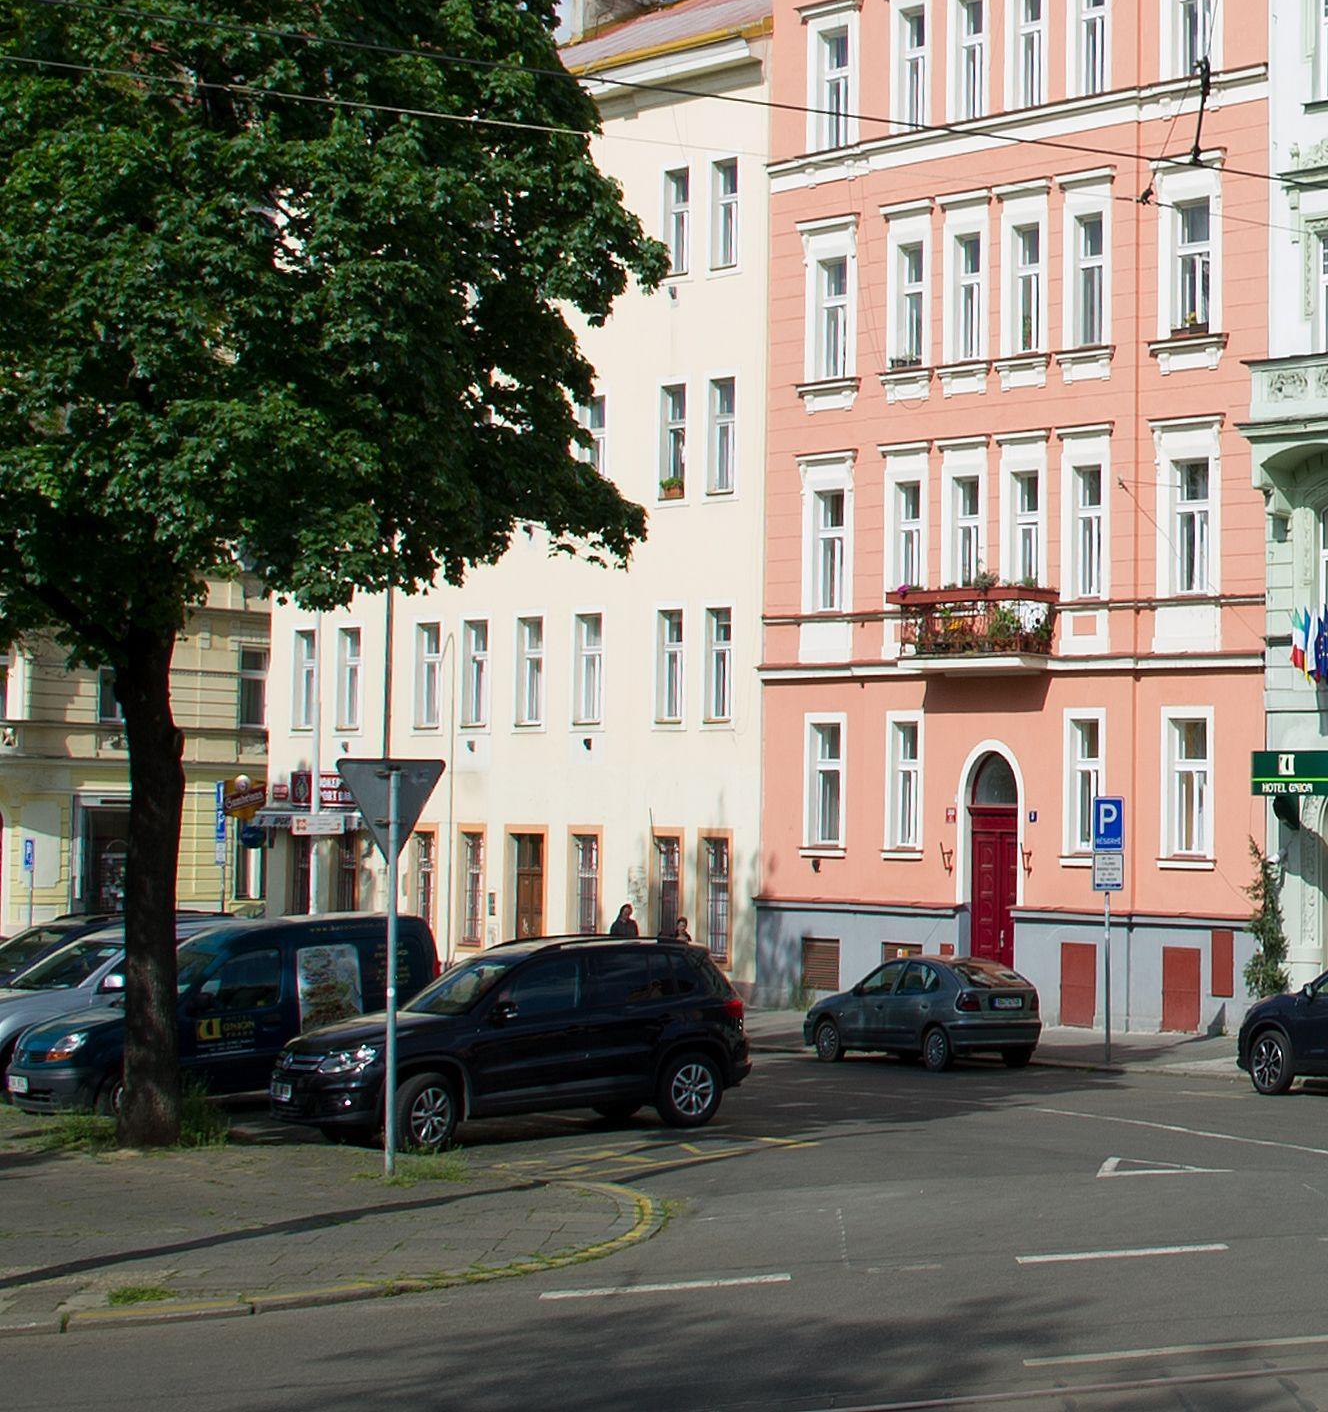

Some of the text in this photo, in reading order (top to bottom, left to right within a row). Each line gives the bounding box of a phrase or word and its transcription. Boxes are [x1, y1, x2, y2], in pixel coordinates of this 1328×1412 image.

[1262, 783, 1313, 794] HOTEL UNION
[1100, 803, 1117, 835] P
